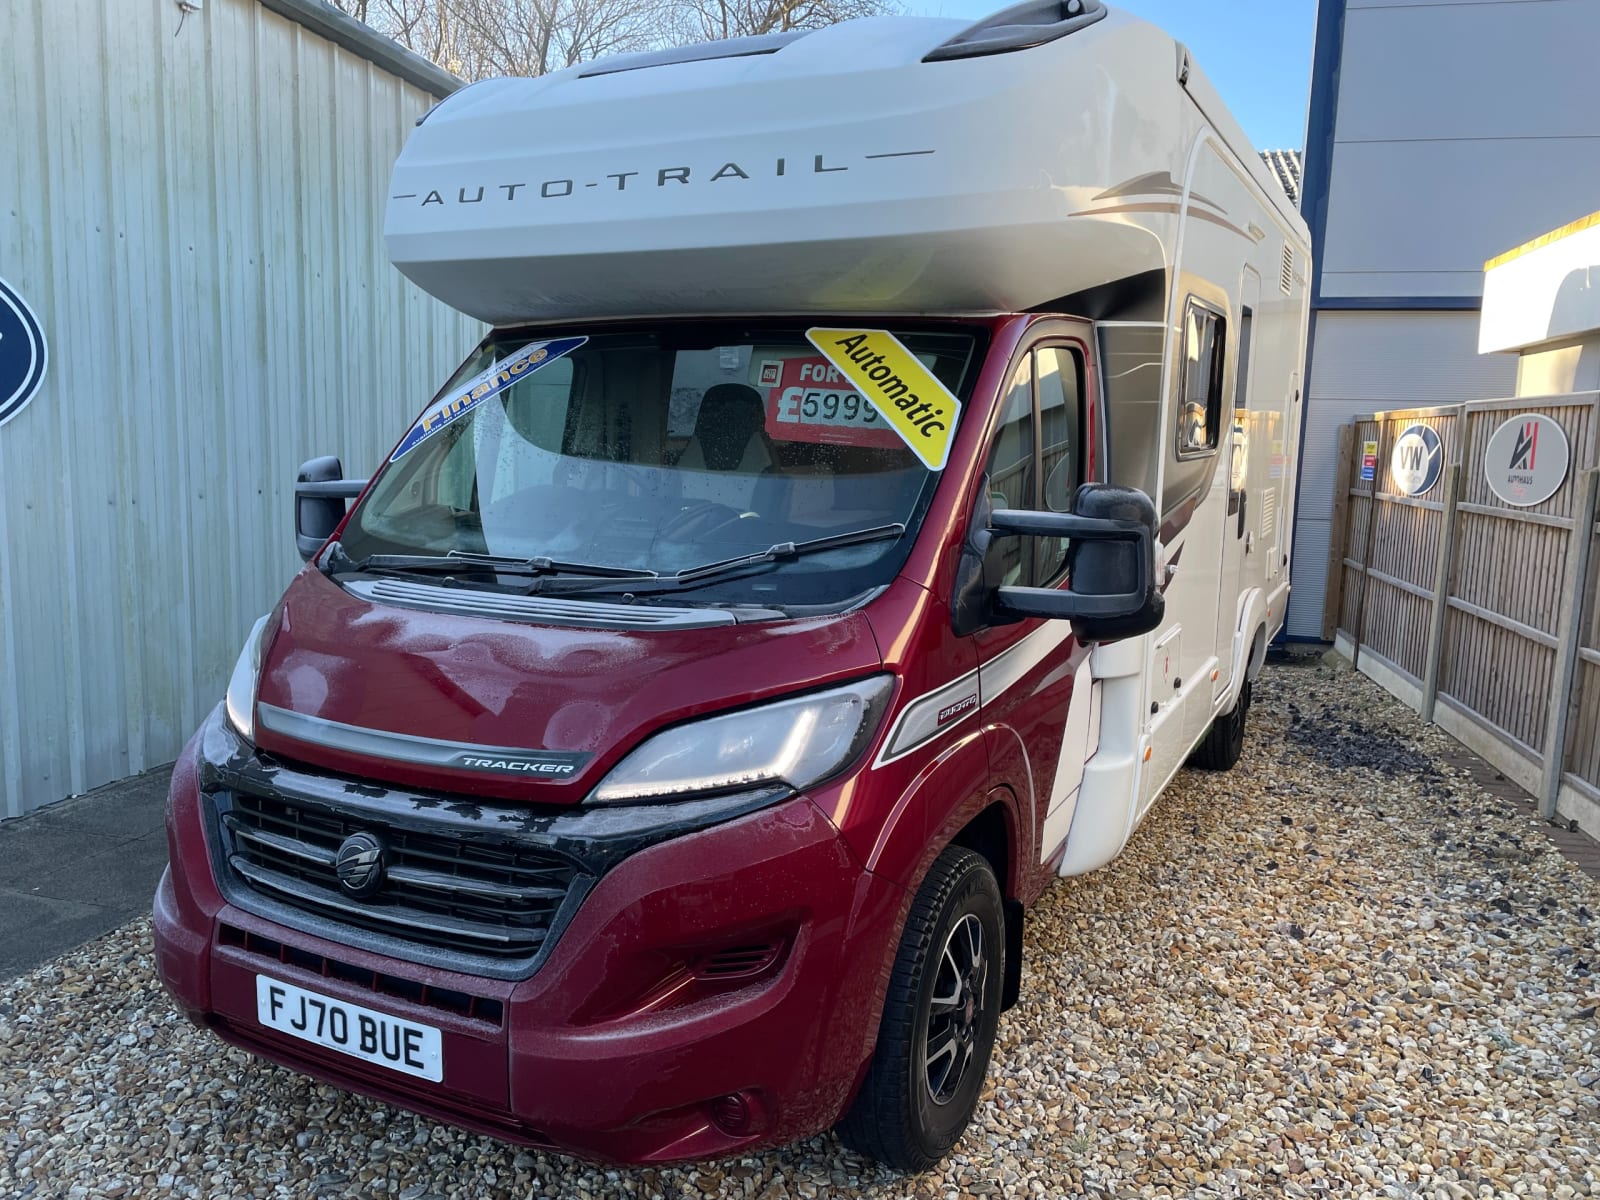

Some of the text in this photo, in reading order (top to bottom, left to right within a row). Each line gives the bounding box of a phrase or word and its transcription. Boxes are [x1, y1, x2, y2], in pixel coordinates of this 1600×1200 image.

[421, 154, 849, 207] AUTO-TRAIL
[422, 348, 548, 432] Finance
[800, 363, 839, 383] FOR
[834, 333, 945, 438] Automatic
[1400, 446, 1423, 471] VW
[463, 757, 574, 773] TRACKER
[270, 985, 425, 1070] FJ70 BUE
